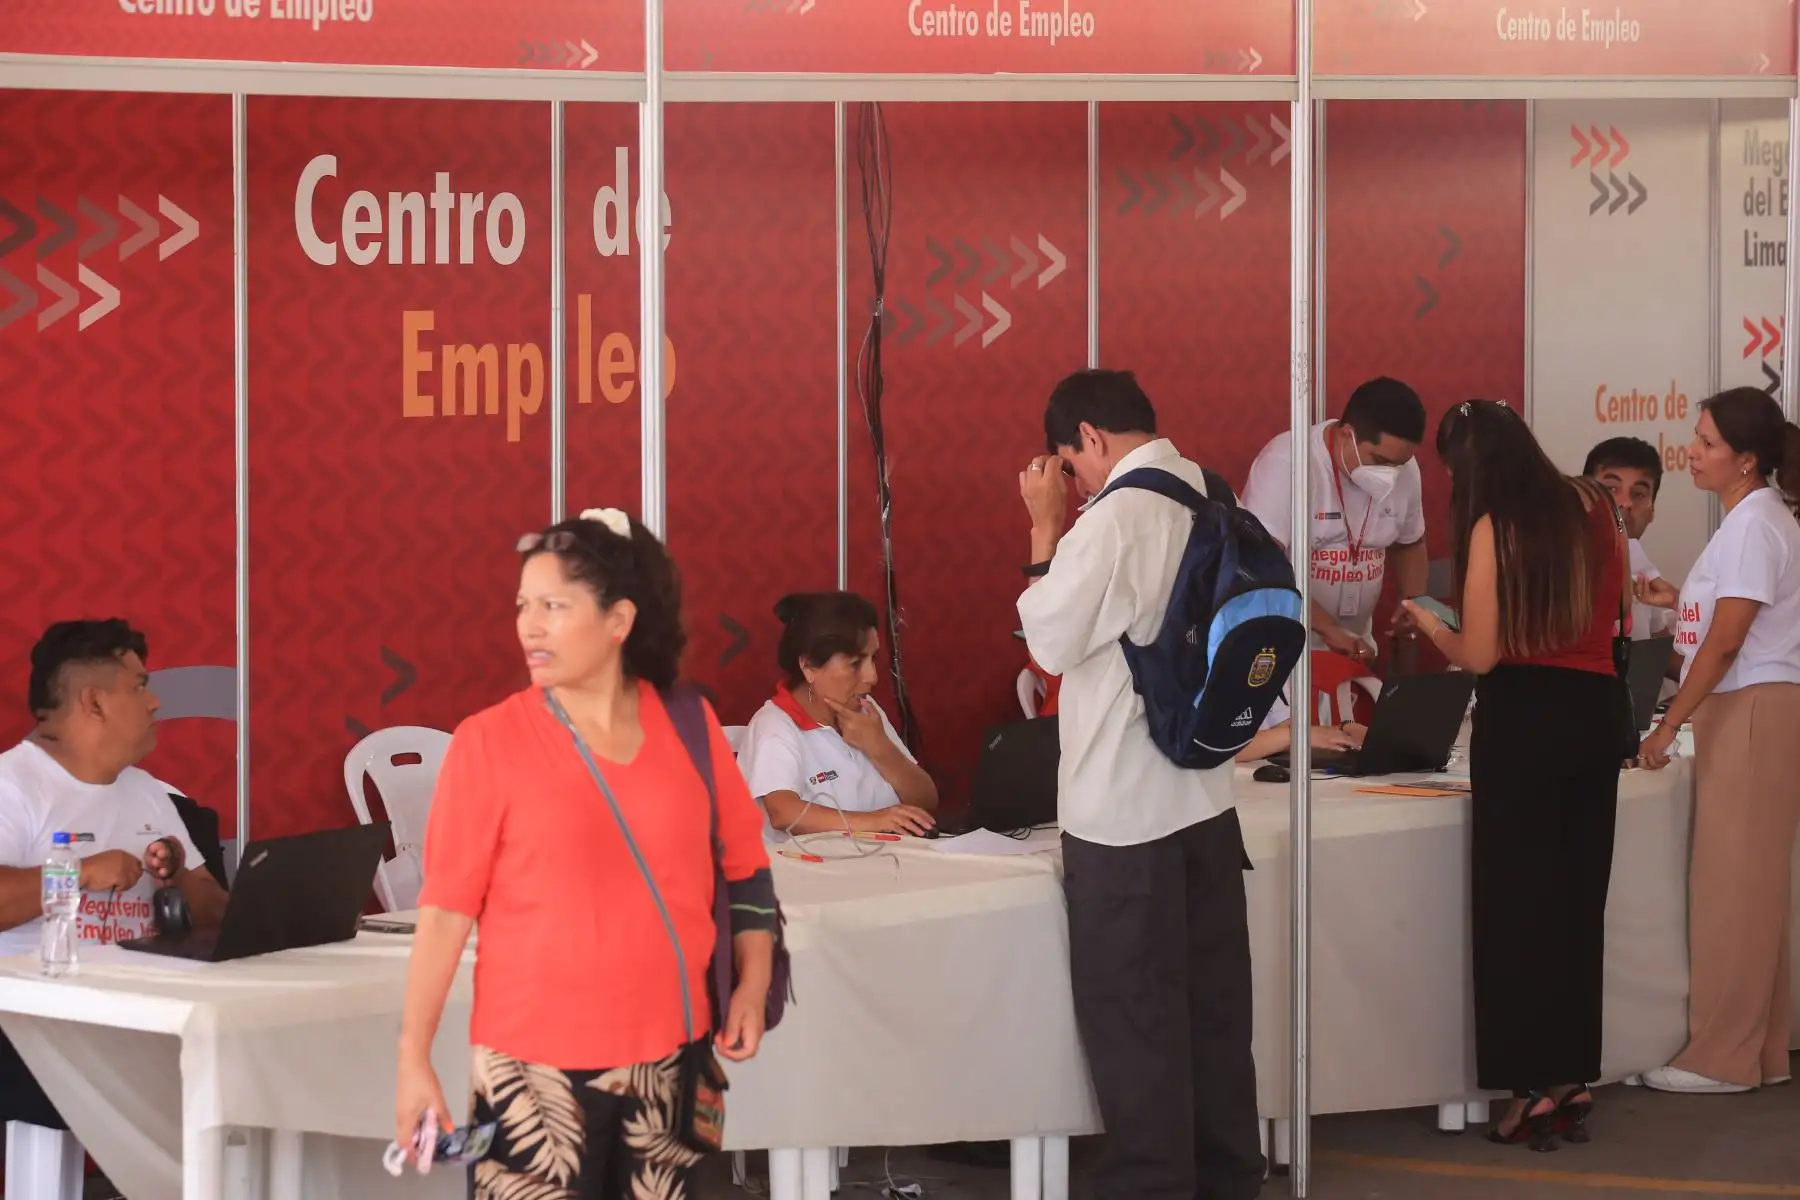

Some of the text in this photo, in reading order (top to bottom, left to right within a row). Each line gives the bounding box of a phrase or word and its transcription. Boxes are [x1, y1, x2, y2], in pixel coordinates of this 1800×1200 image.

[908, 0, 1095, 46] Centro de Empleo
[1496, 6, 1640, 49] Centro de Empleo
[294, 154, 526, 266] Centro
[1743, 176, 1772, 217] del
[1594, 379, 1688, 423] Centro de
[1682, 601, 1700, 622] del
